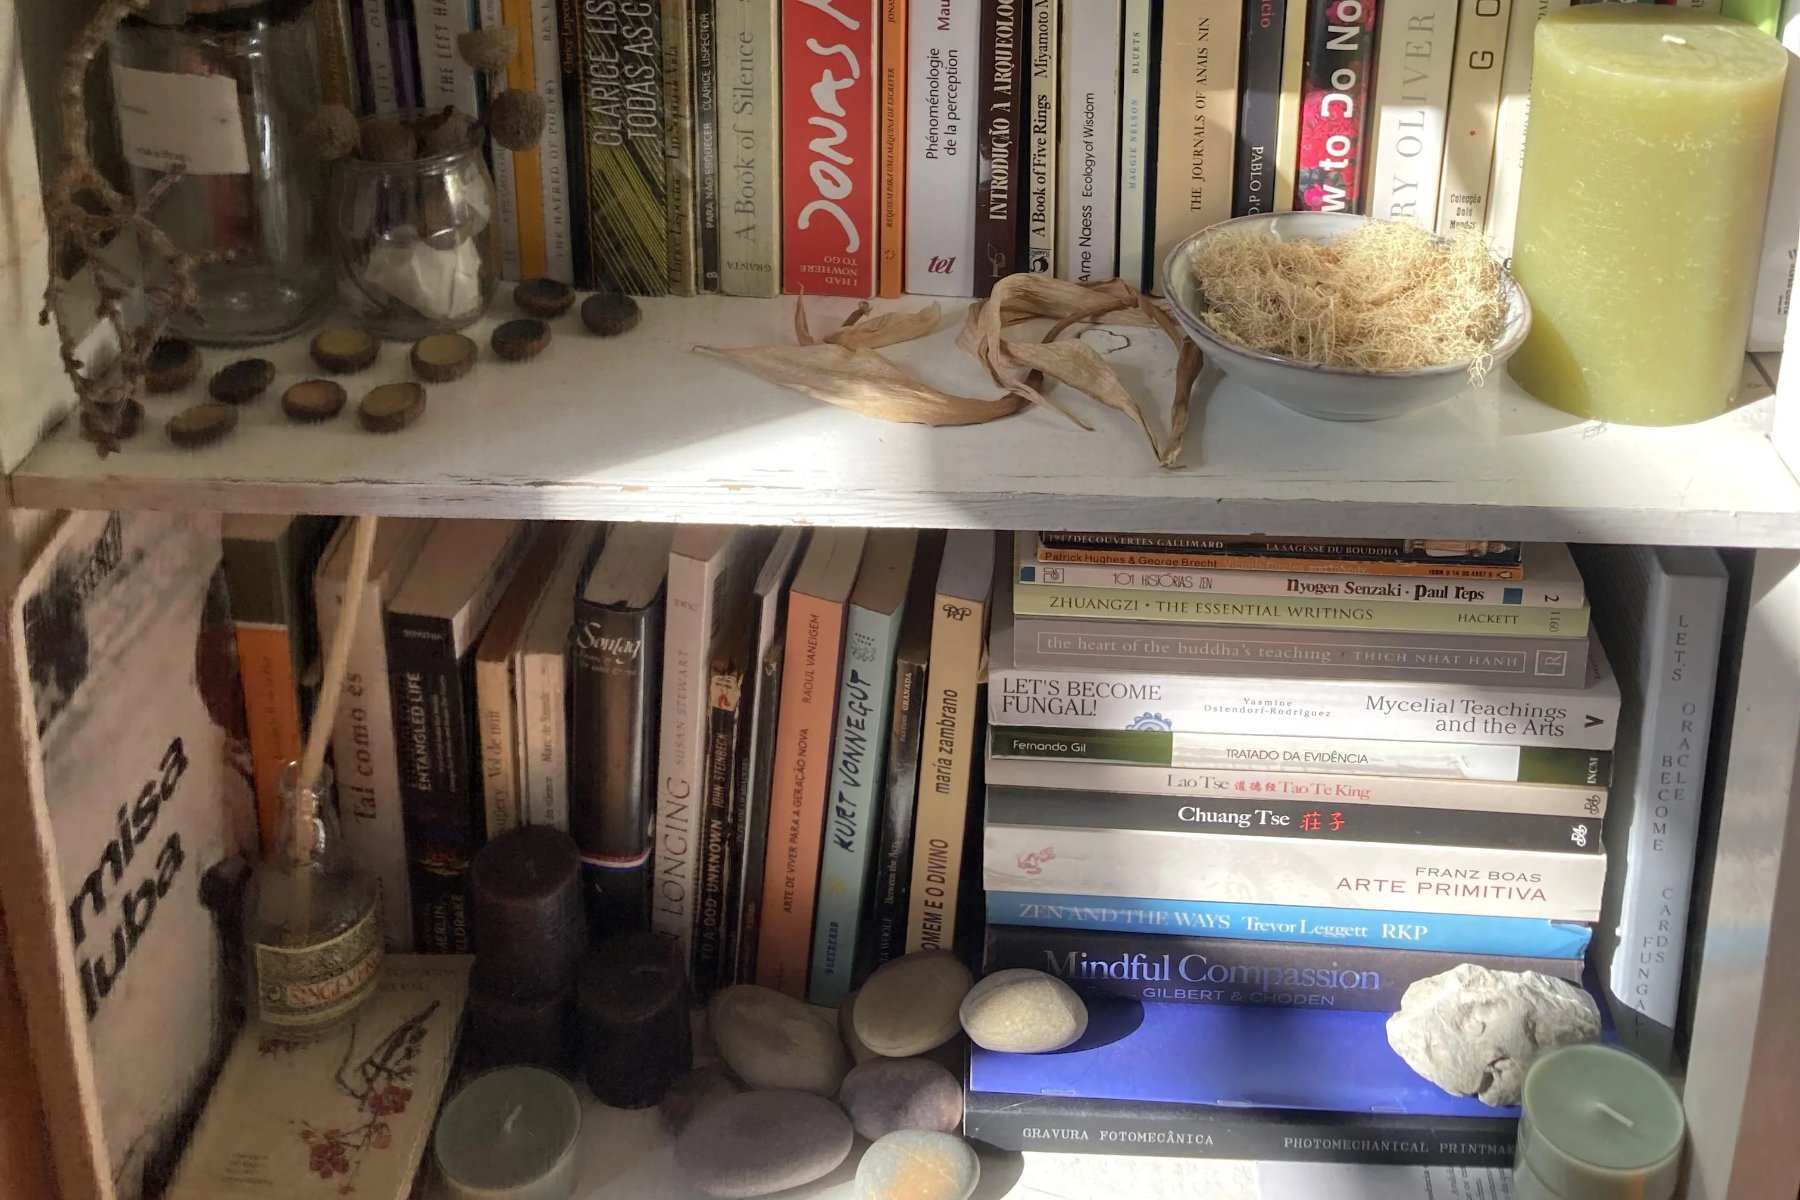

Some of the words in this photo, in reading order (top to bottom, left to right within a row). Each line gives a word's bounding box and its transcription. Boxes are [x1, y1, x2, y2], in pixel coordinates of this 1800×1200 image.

[621, 26, 652, 56] AS
[1197, 17, 1210, 42] NIN
[1033, 12, 1051, 78] Miyamoto
[1131, 31, 1141, 75] BLUETS
[733, 32, 754, 116] Silence
[1195, 47, 1209, 86] ANAIS
[590, 51, 624, 146] CLARICE
[943, 49, 961, 120] perception
[1396, 12, 1436, 157] OLIVER
[624, 65, 659, 140] TODAS
[925, 49, 943, 159] Phénoménologie
[990, 100, 1013, 112] À
[1034, 94, 1051, 134] Rings
[1194, 92, 1206, 110] OF
[733, 126, 754, 150] of
[798, 37, 860, 254] JONAS
[943, 125, 958, 137] la
[943, 140, 958, 156] de
[1033, 138, 1048, 168] Five
[1191, 115, 1205, 181] JOURNALS
[1317, 134, 1349, 171] to
[986, 118, 1013, 220] INTRODUÇÃO
[1032, 171, 1047, 184] of
[734, 157, 756, 216] Book
[1190, 187, 1202, 212] THE
[1032, 188, 1047, 222] Book
[735, 224, 756, 243] A
[1033, 225, 1047, 238] A
[1049, 597, 1139, 611] ZHUANGZI
[1156, 600, 1188, 614] THE
[1195, 601, 1281, 617] ESSENTIAL
[1288, 605, 1373, 621] WRITINGS
[1458, 612, 1520, 625] HACKETT
[805, 614, 820, 666] VANEIGEM
[406, 672, 424, 701] LIFE
[802, 669, 814, 703] RAOUL
[1003, 678, 1062, 695] LET'S
[1067, 680, 1161, 700] BECOME
[1003, 695, 1098, 716] FUNGAL!
[1365, 696, 1455, 719] Mycelial
[1461, 700, 1567, 725] Teachings
[839, 669, 870, 787] VONNEGUT
[935, 689, 958, 755] zambrano
[1436, 717, 1478, 734] and
[1484, 717, 1514, 734] the
[1522, 718, 1565, 737] Arts
[410, 706, 431, 790] ENTANGLED
[797, 729, 809, 756] NOVA
[1013, 739, 1066, 753] Fernando
[1069, 741, 1086, 753] Gil
[1226, 748, 1279, 761] TRATADO
[1282, 750, 1300, 762] DA
[1304, 749, 1369, 764] EVIDÊNCIA
[792, 759, 807, 807] GERAÇÃO
[933, 757, 952, 794] maría
[1200, 776, 1229, 790] Tse
[1278, 781, 1308, 794] Tao
[1310, 783, 1332, 796] Te
[1336, 785, 1371, 801] King
[789, 819, 800, 843] PARA
[833, 793, 857, 853] KURT
[1178, 806, 1250, 827] Chuang
[1254, 811, 1290, 826] Tse
[70, 736, 189, 944] misa
[663, 777, 690, 916] LONGING
[786, 846, 798, 873] VIVER
[1415, 866, 1481, 881] FRANZ
[1487, 869, 1542, 882] BOAS
[784, 876, 795, 890] DE
[1336, 876, 1410, 895] ARTE
[1417, 879, 1546, 902] PRIMITIVA
[783, 891, 794, 913] ARTE
[79, 831, 185, 1019] luba
[1019, 903, 1062, 919] ZEN
[1066, 906, 1112, 923] AND
[1115, 910, 1167, 926] THE
[1172, 912, 1230, 929] WAYS
[1242, 917, 1296, 933] Trevor
[1300, 920, 1368, 939] Leggett
[1382, 922, 1428, 941] RKP
[1043, 949, 1171, 982] Mindful
[1178, 954, 1380, 990] Compassion
[1022, 1126, 1089, 1141] GRAVURA
[1099, 1128, 1214, 1146] FOTOMECÂNICA
